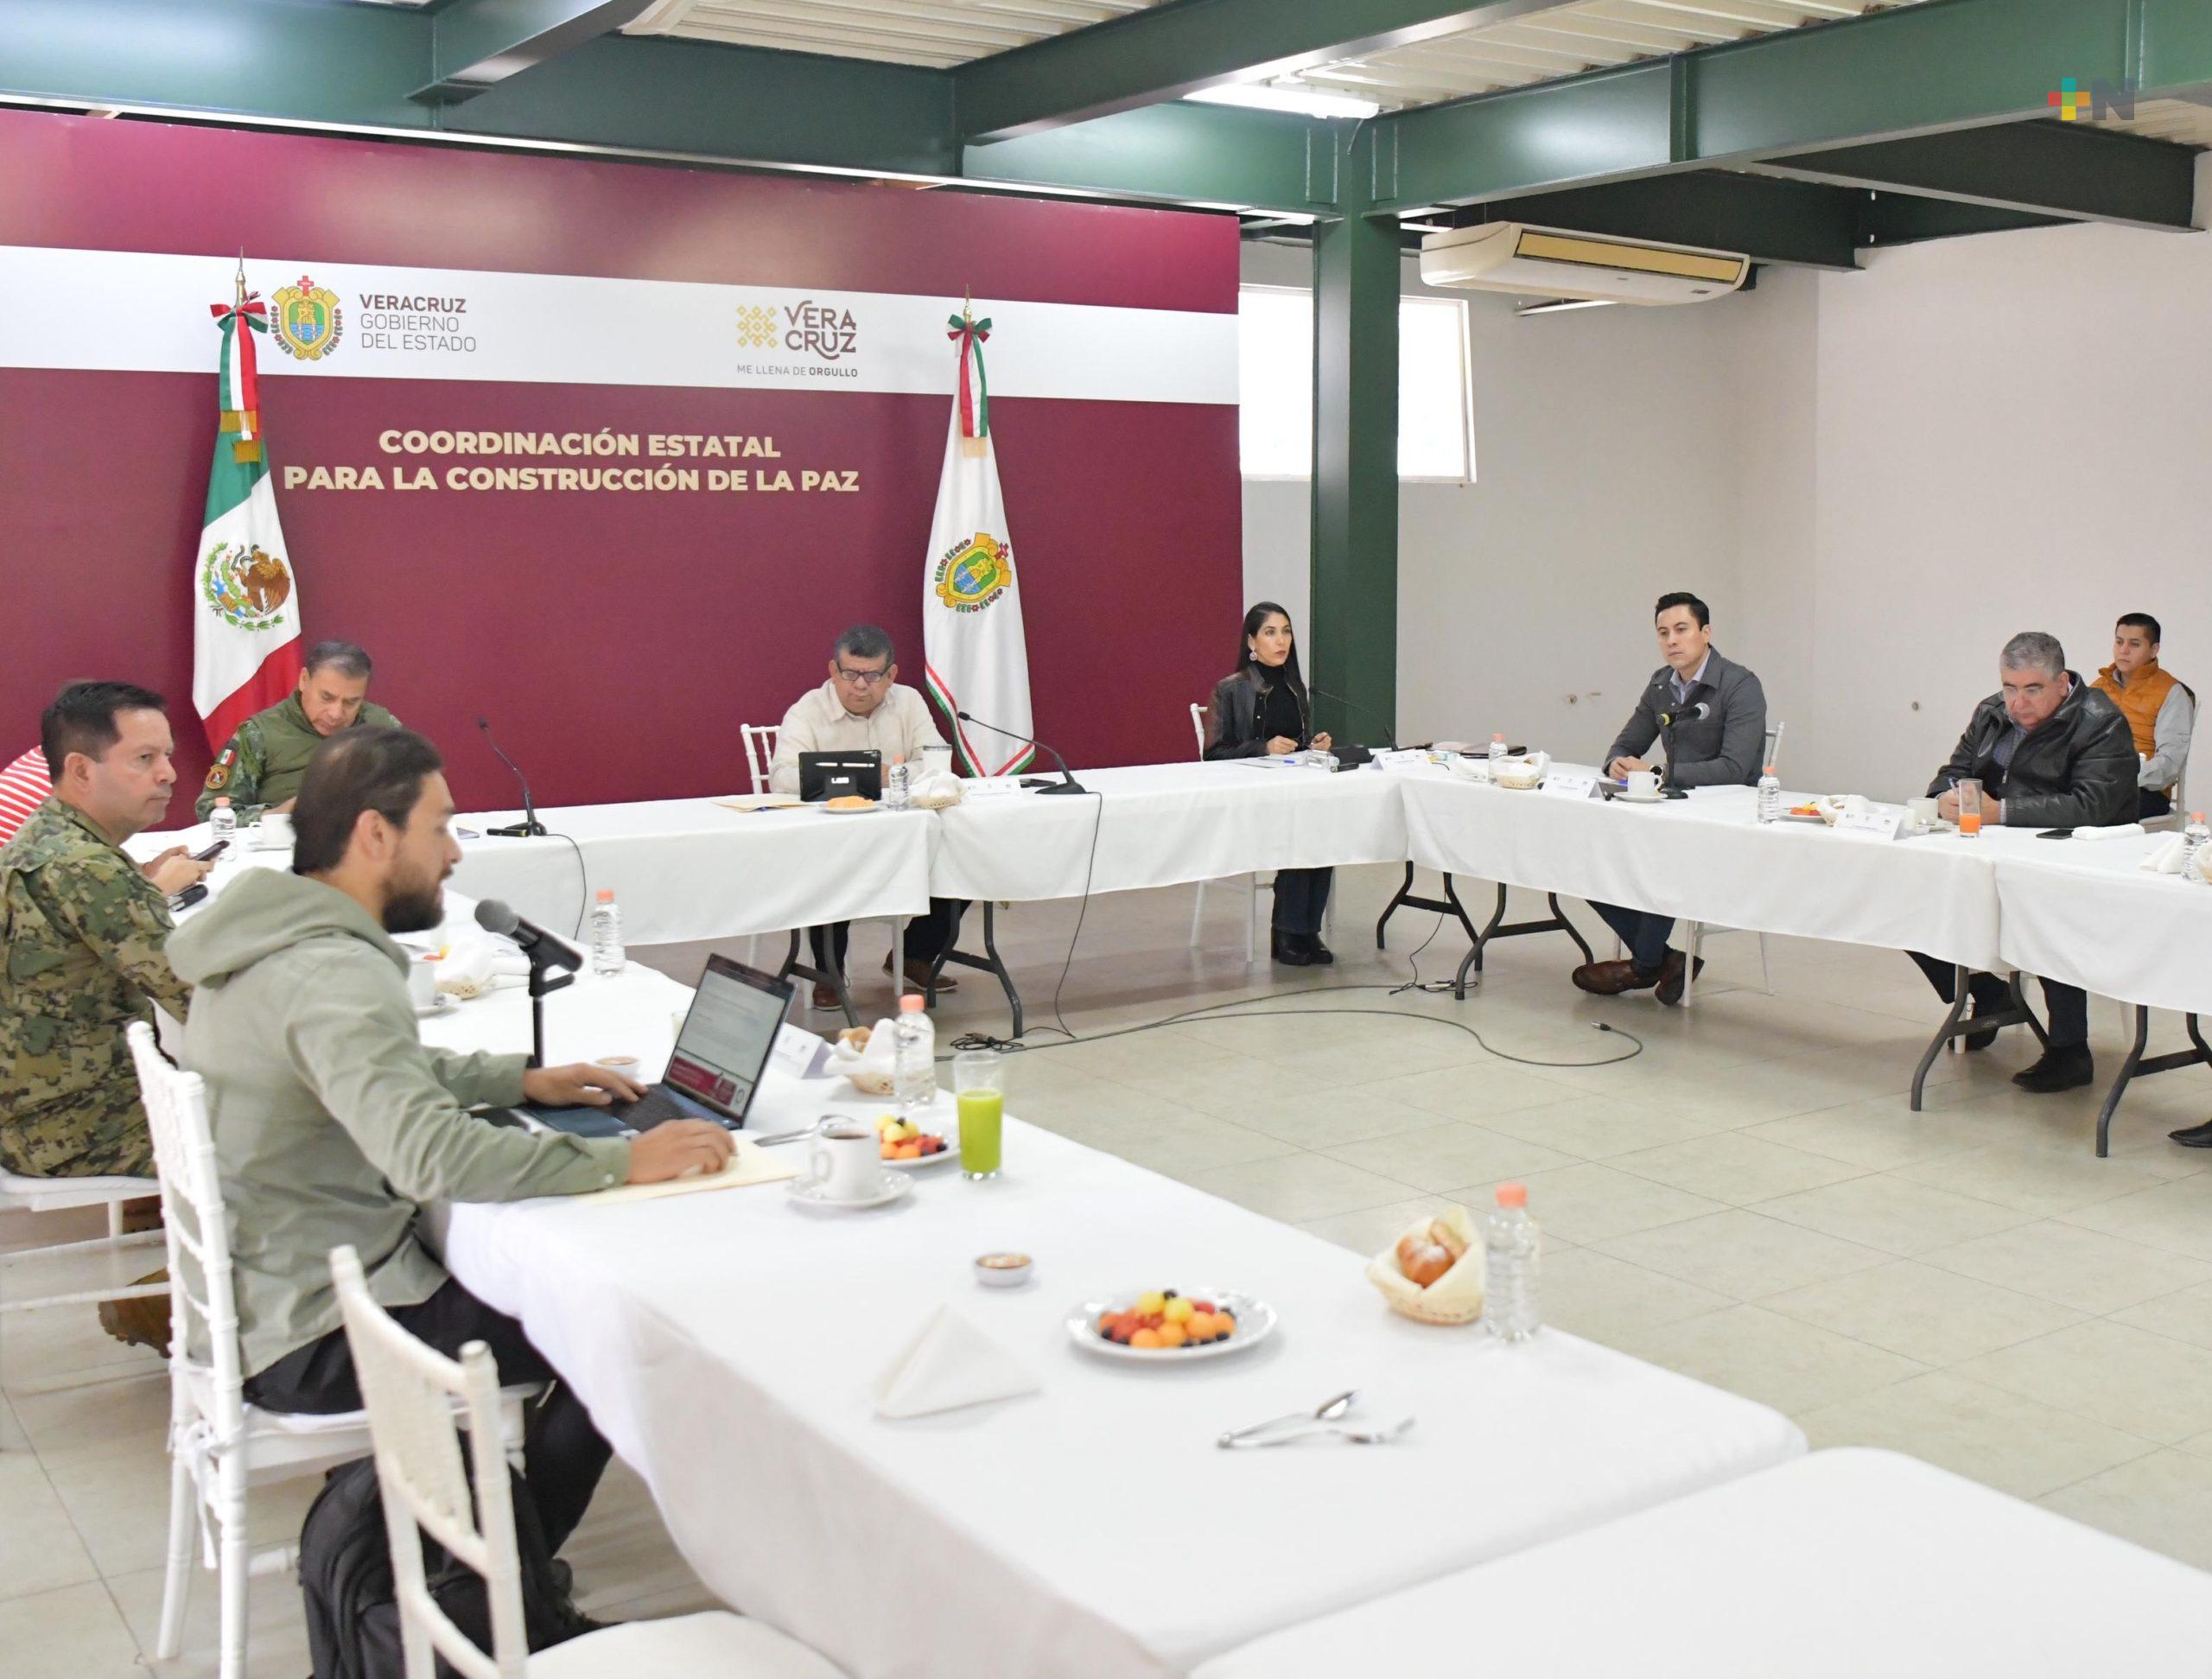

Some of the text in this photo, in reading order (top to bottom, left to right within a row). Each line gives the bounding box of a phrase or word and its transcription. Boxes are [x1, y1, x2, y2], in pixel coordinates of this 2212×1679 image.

[359, 293, 467, 314] VERACRUZ
[785, 300, 857, 331] VERA
[360, 313, 460, 333] GOBIERNO
[361, 333, 477, 353] DEL ESTADO
[785, 330, 857, 359] CRUZ
[737, 364, 858, 378] ME LLENA DE ORGULLO
[378, 427, 781, 458] COORDINACIÓN ESTATAL
[284, 462, 860, 493] PARA LA CONSTRUCCIÓN DE LA PAZ
